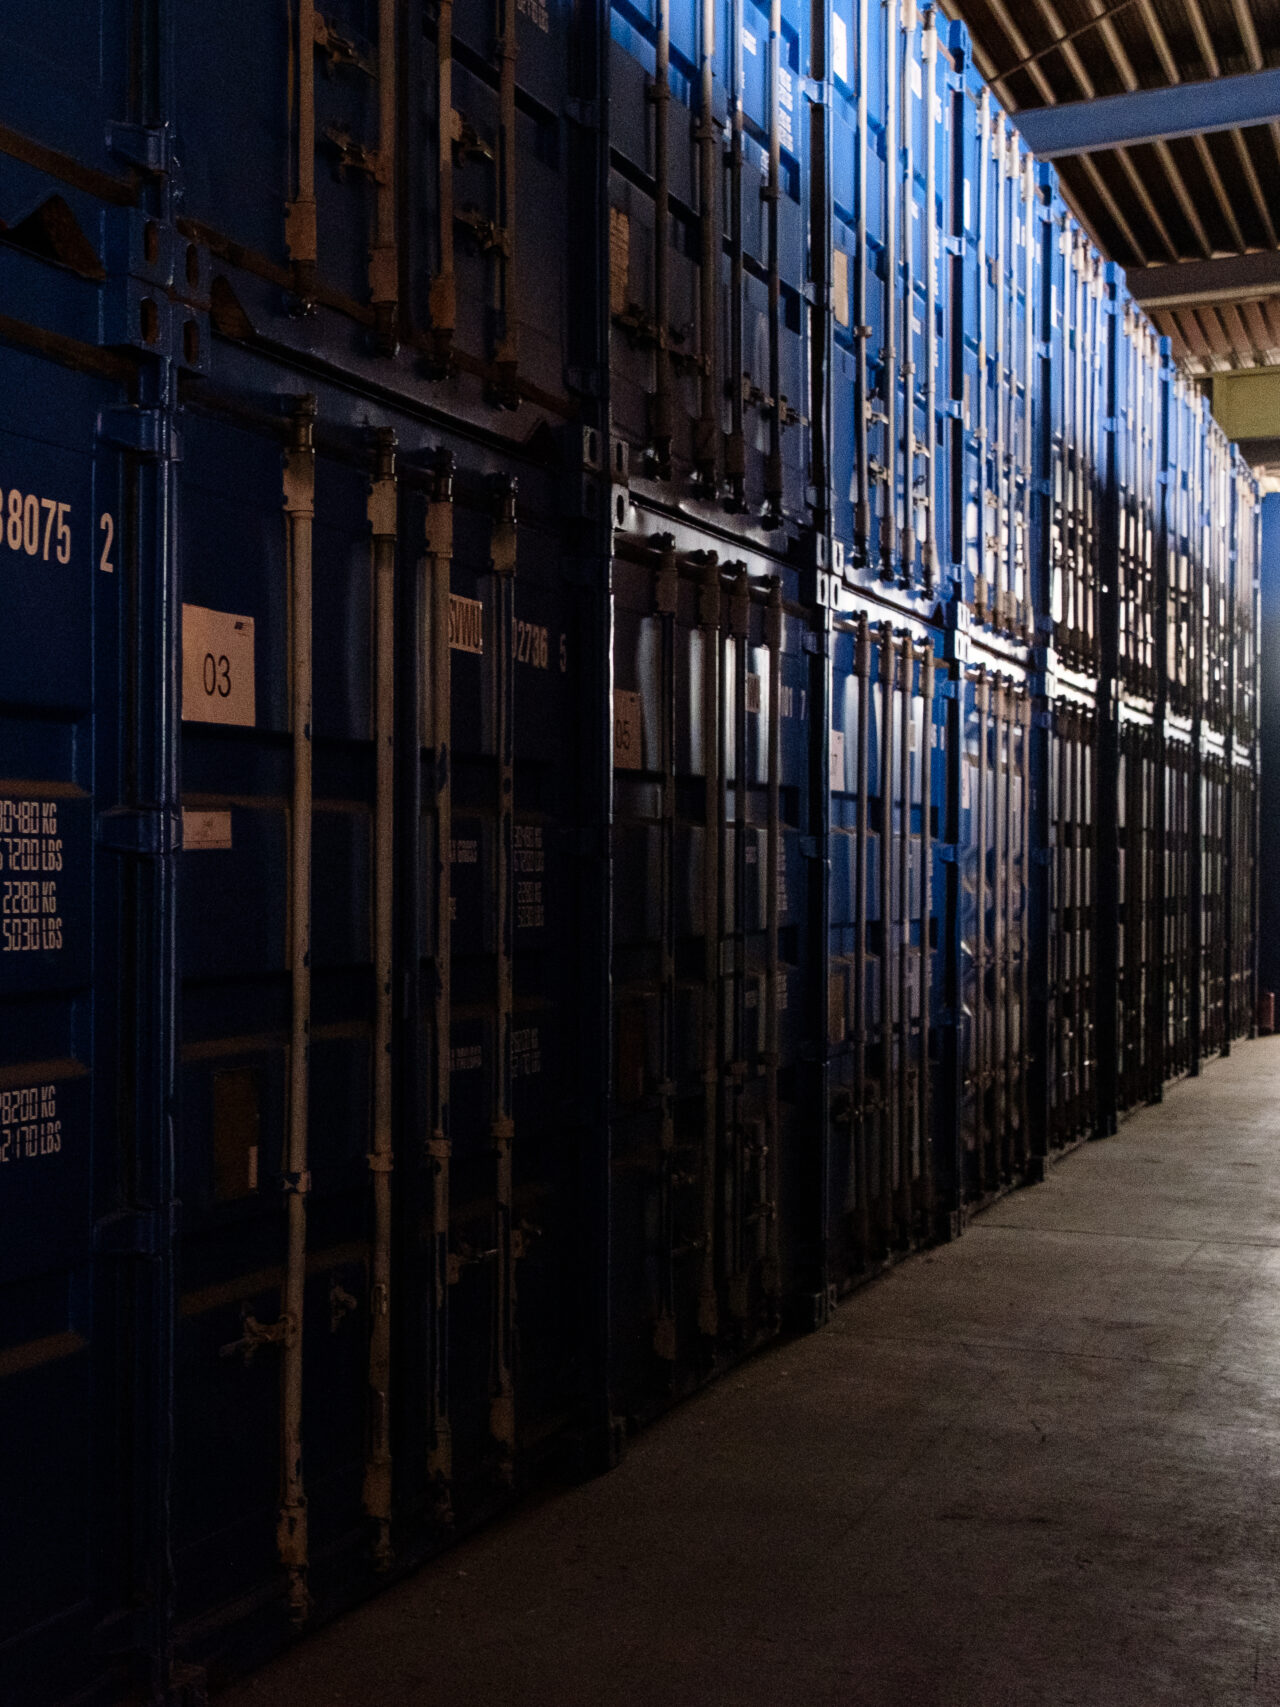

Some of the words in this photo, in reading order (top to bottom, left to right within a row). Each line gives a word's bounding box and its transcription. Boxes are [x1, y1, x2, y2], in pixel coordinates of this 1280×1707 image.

[99, 512, 114, 573] 2
[203, 653, 231, 697] 03
[41, 802, 58, 835] KG
[41, 839, 64, 872] LBS
[2, 881, 40, 915] 2280
[41, 880, 57, 914] KG
[2, 918, 40, 952] 5030
[41, 917, 64, 951] LBS
[40, 1084, 57, 1119] KG
[40, 1120, 62, 1156] LBS
